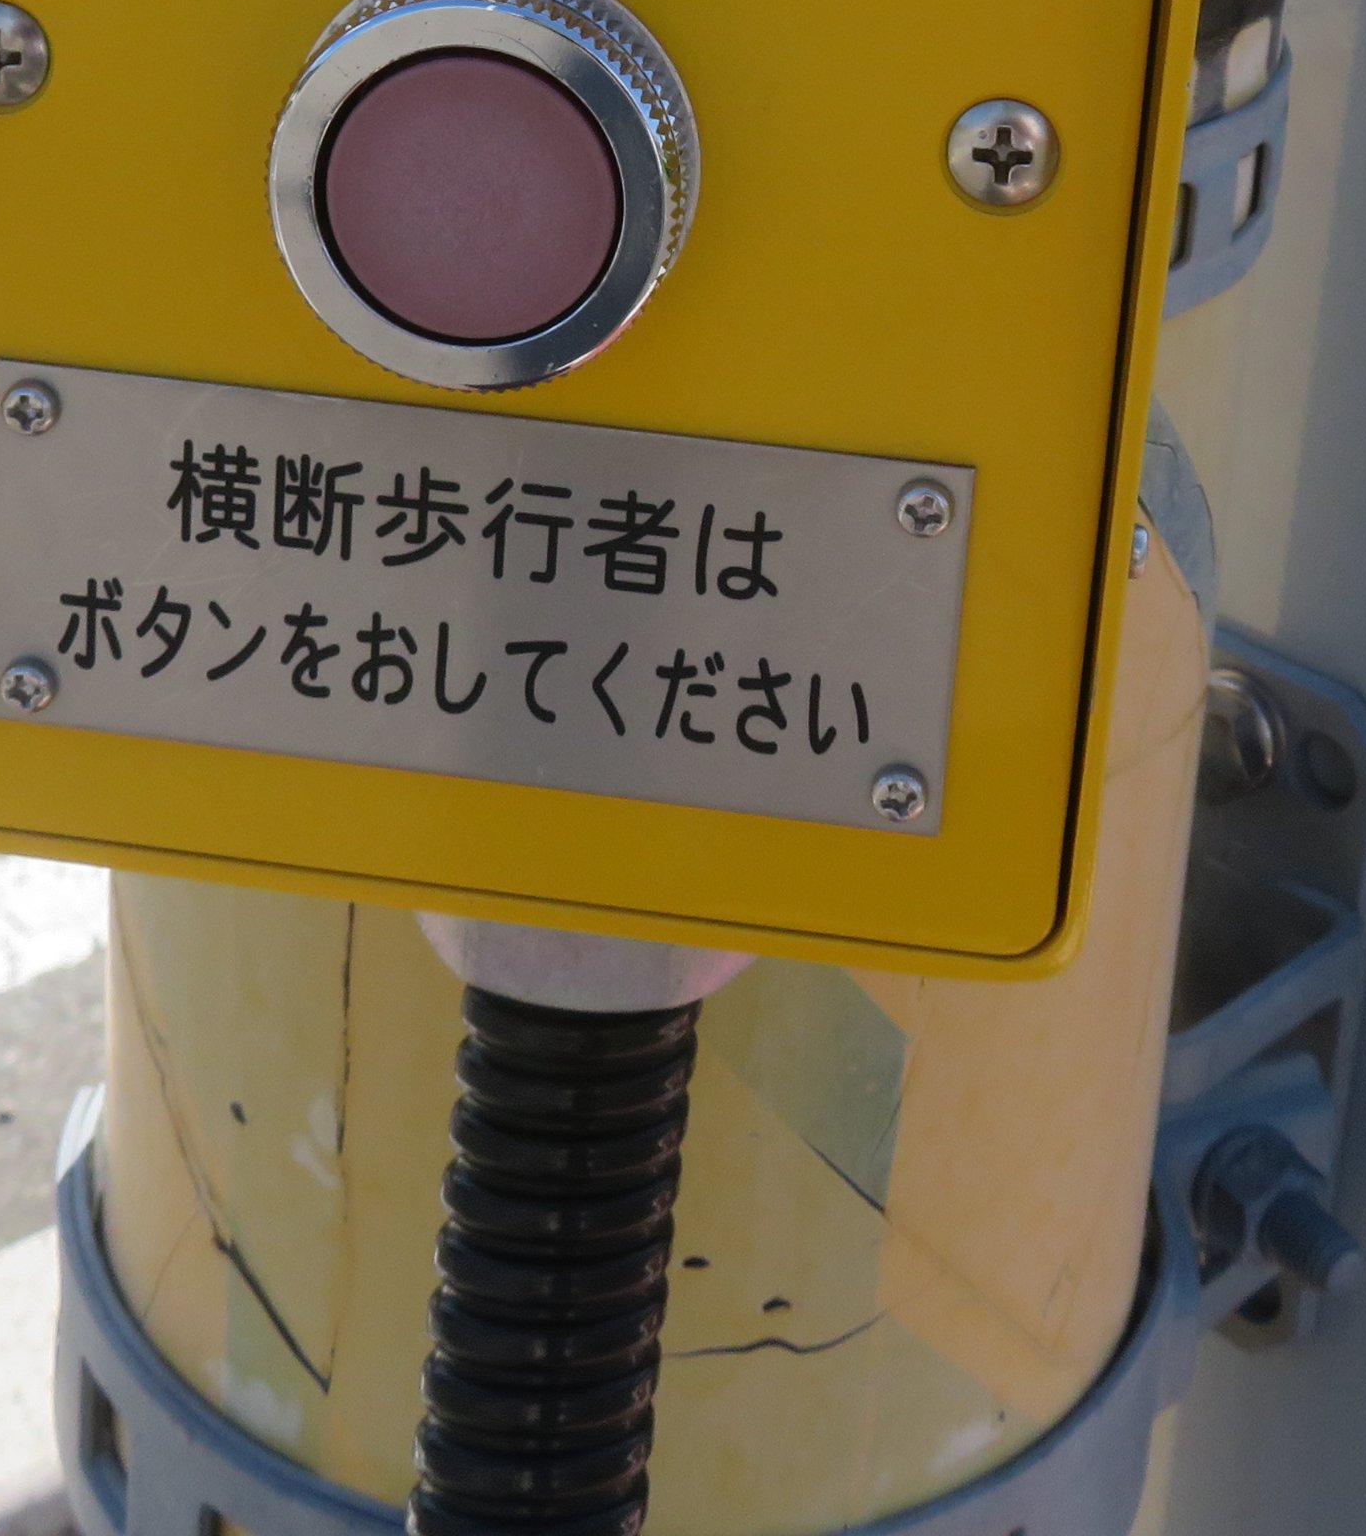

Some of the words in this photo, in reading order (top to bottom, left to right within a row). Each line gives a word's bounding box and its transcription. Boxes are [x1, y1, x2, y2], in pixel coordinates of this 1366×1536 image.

[165, 438, 784, 601] 横断歩行者は
[57, 576, 871, 756] ボタンをおしてください
